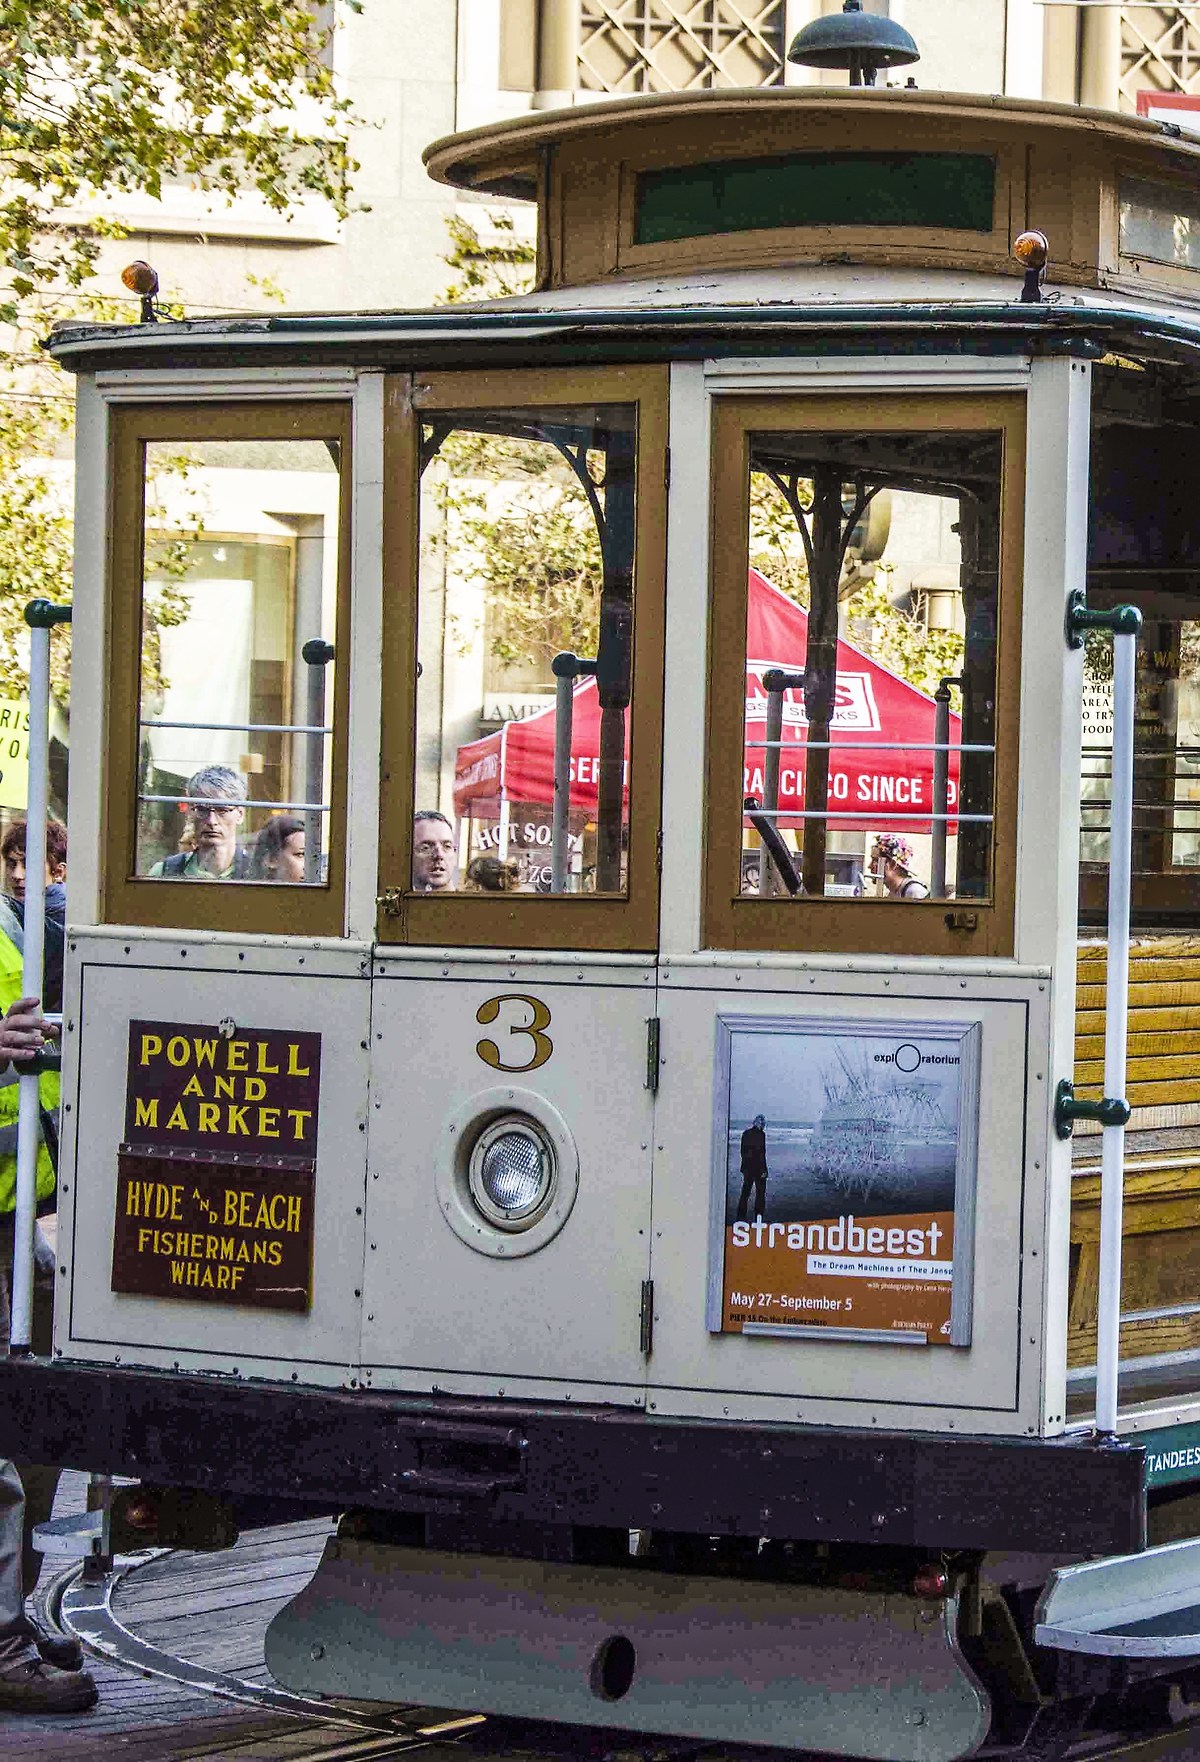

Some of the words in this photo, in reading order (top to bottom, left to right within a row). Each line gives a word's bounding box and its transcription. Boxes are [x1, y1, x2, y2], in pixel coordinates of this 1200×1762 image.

[857, 774, 923, 804] SINCE
[476, 993, 554, 1073] 3
[140, 1034, 311, 1077] POWELL
[183, 1074, 267, 1102] AND
[134, 1098, 312, 1140] MARKET
[126, 1180, 185, 1222] HYDE
[223, 1189, 302, 1233] BEACH
[138, 1229, 284, 1266] FISHERMANS
[732, 1213, 943, 1256] strandbeest
[171, 1260, 245, 1290] WHARF
[812, 1260, 827, 1269] The
[829, 1261, 855, 1270] Dream
[858, 1263, 894, 1272] Machines
[897, 1265, 906, 1273] of
[909, 1266, 928, 1274] Theo
[731, 1292, 755, 1308] May
[844, 1298, 853, 1311] 5
[1142, 1447, 1200, 1473] TANDEES
